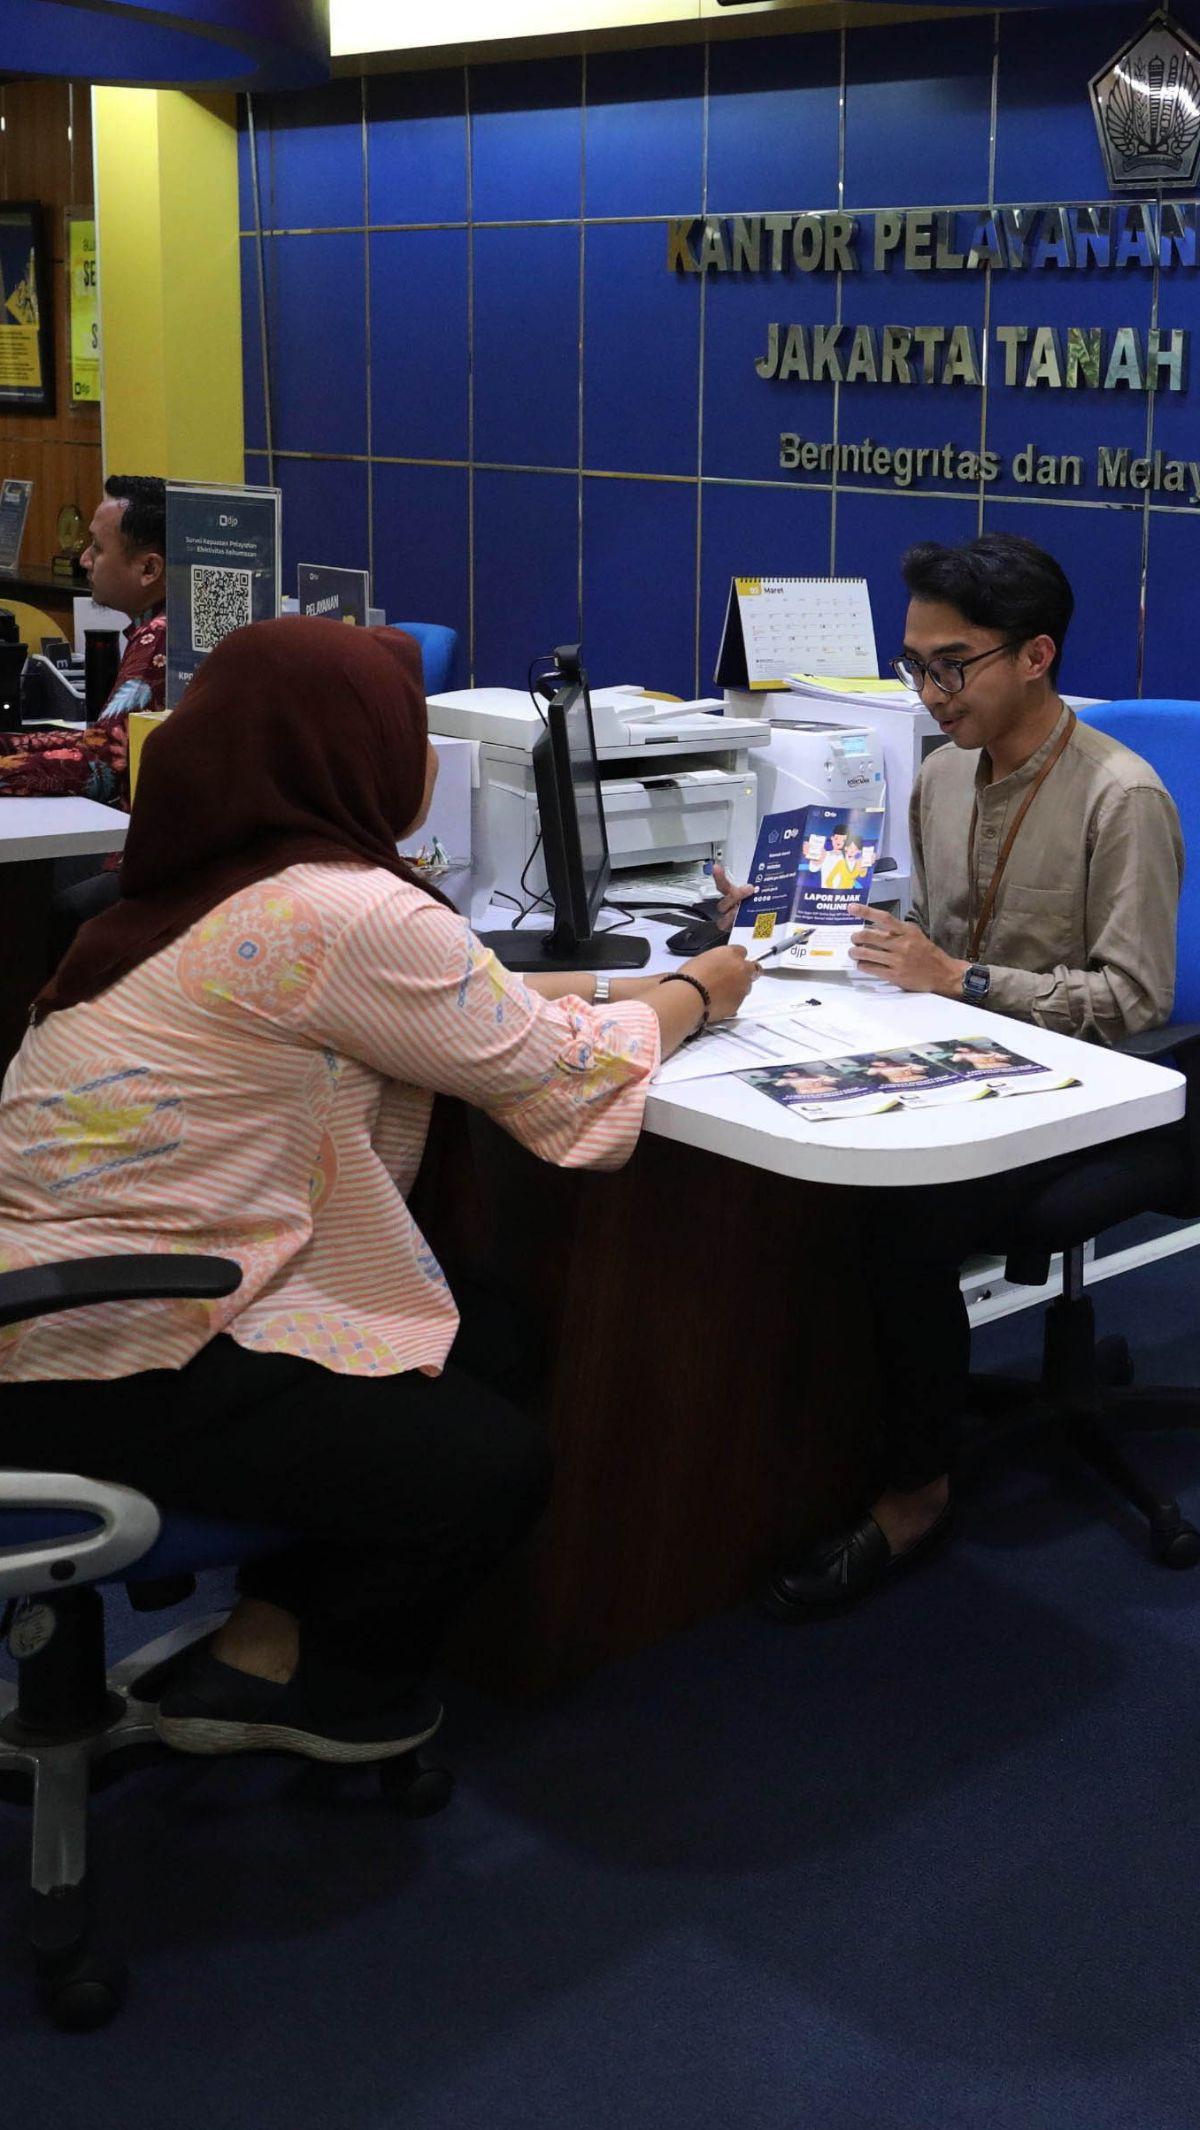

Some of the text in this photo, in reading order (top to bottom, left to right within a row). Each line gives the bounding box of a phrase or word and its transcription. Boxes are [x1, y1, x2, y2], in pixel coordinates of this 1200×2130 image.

[667, 207, 1198, 272] KANTOR PELAYANAN
[755, 323, 1187, 391] JAKARTA TANAH
[779, 432, 1000, 487] Berintegritas
[1012, 444, 1085, 486] dan
[764, 586, 784, 594] Maret
[306, 594, 339, 616] PELAYANAN
[804, 892, 861, 902] LAPOR PAJAK
[790, 946, 807, 958] djp
